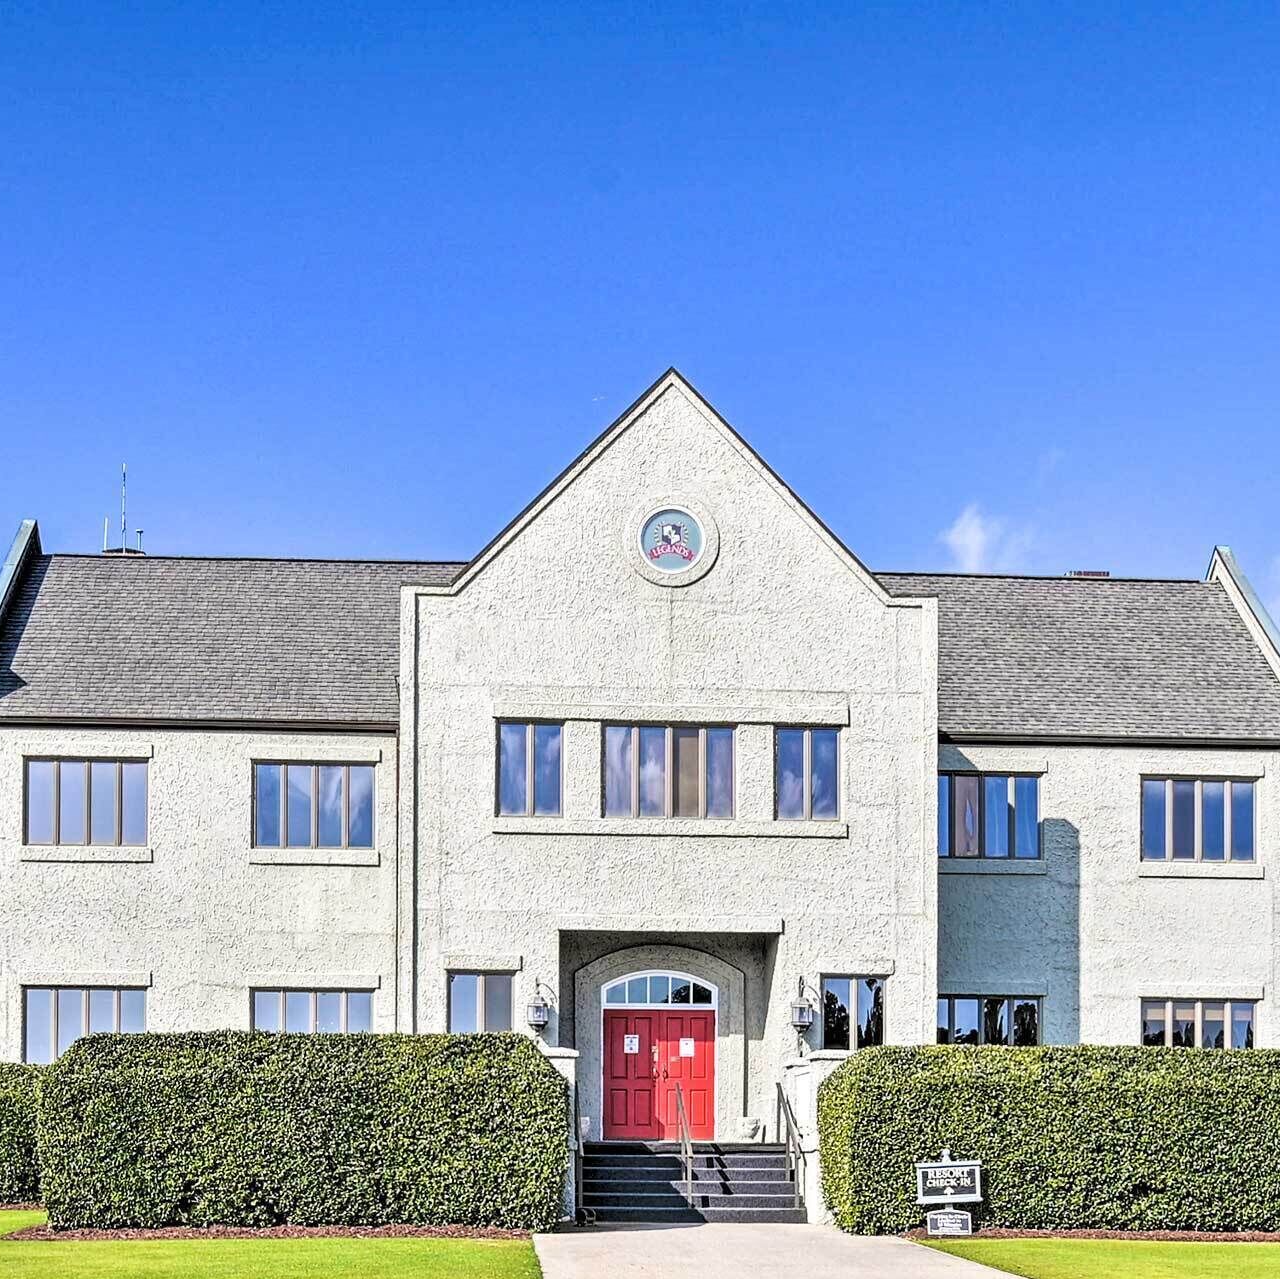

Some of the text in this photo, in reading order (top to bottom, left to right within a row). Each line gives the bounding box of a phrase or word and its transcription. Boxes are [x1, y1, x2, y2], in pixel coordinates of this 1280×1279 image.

[652, 545, 689, 557] LEGENDS
[928, 1169, 968, 1179] RESORT
[926, 1177, 971, 1188] CHECK-IN
